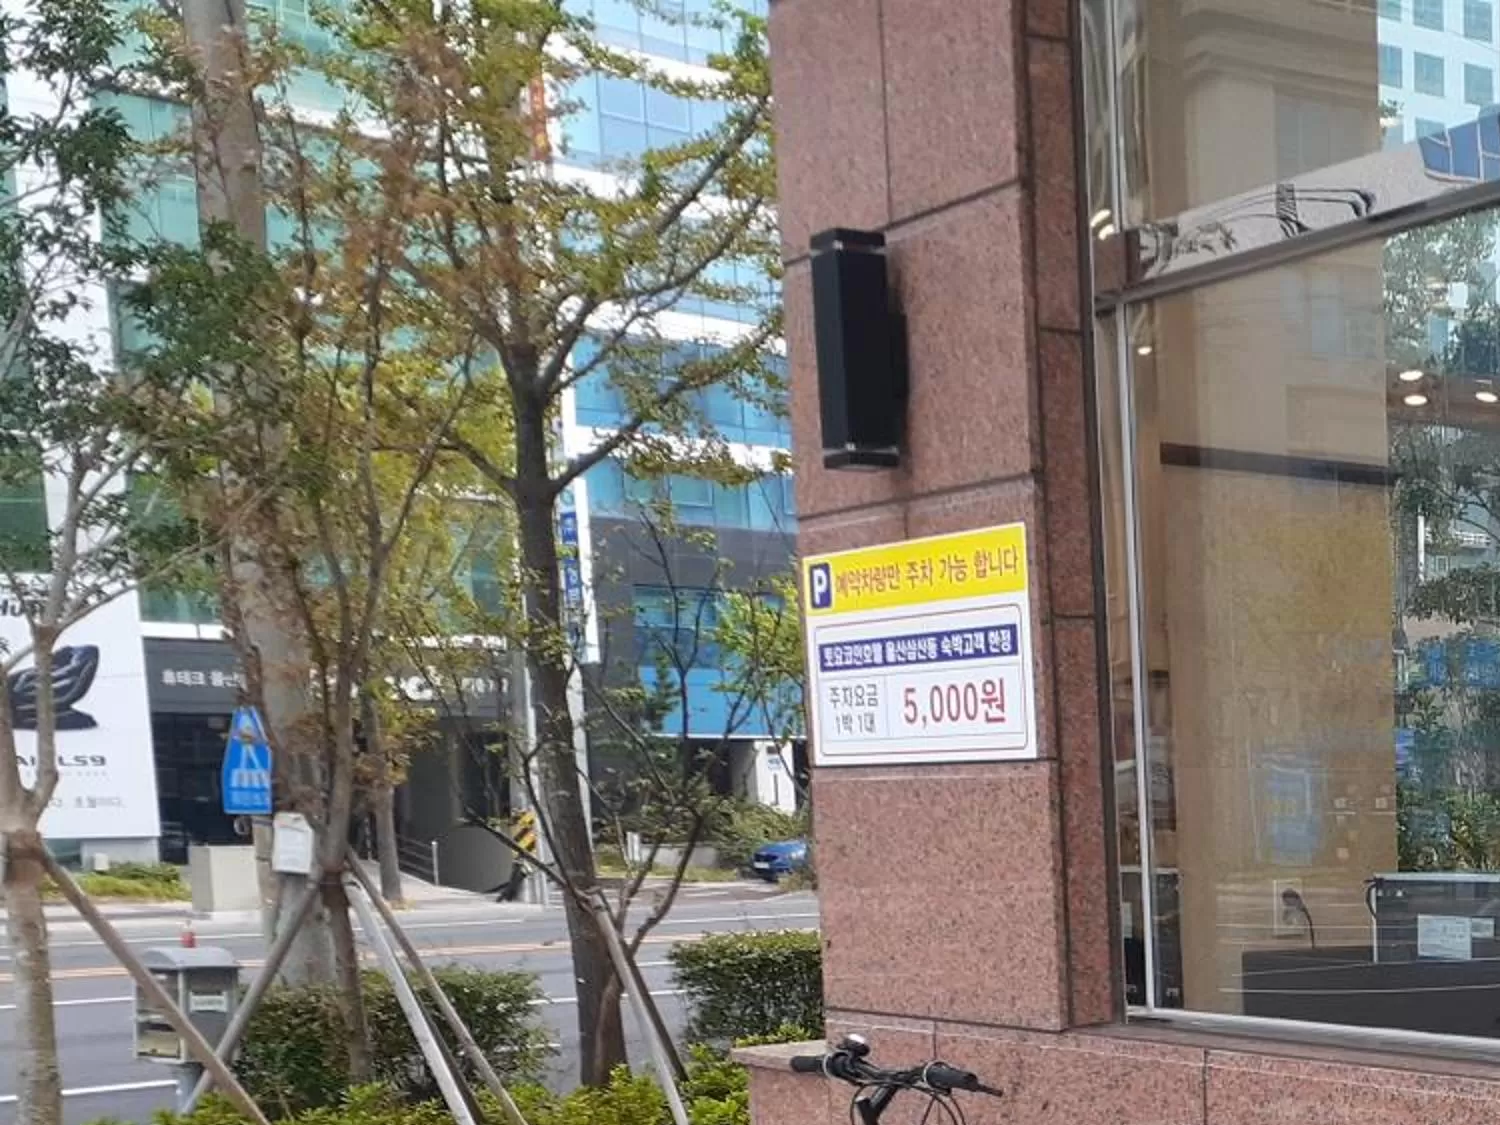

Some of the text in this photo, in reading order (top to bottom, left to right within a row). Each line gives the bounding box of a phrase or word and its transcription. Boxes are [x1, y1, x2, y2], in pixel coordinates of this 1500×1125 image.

[905, 558, 934, 589] 주차
[938, 553, 968, 585] 가능
[973, 545, 1019, 580] 합니다
[812, 568, 829, 605] P
[988, 628, 1012, 653] 한정
[829, 682, 879, 709] 주차요금
[904, 677, 1006, 729] 5,000원
[835, 711, 877, 735] 1박 1대
